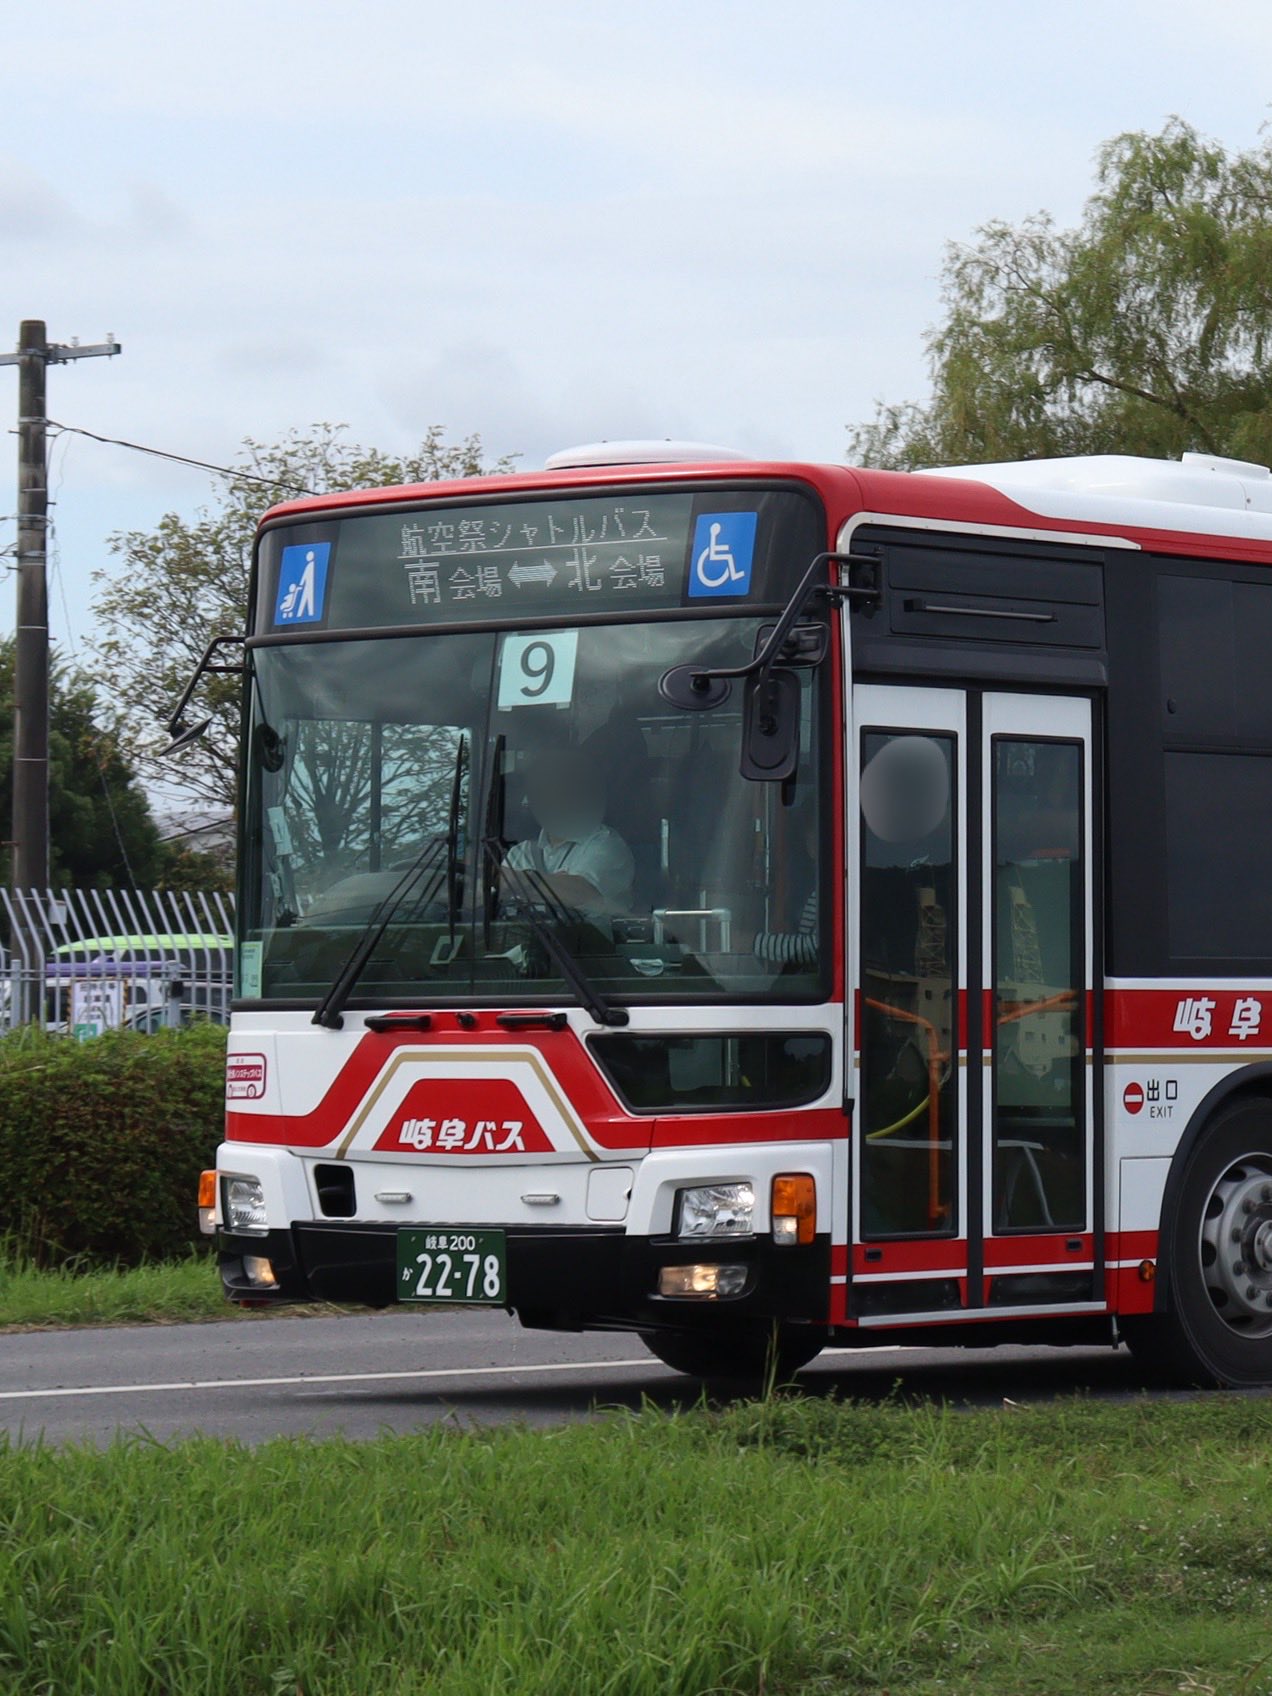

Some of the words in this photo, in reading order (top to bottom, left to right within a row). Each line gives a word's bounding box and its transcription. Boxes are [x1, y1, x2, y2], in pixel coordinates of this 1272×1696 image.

[400, 507, 657, 556] 航空祭シャトルバス
[520, 640, 556, 697] 9
[1147, 1079, 1178, 1101] 出口
[1150, 1105, 1173, 1118] EXIT
[398, 1118, 526, 1151] 岐阜バス
[416, 1253, 500, 1298] 22-78
